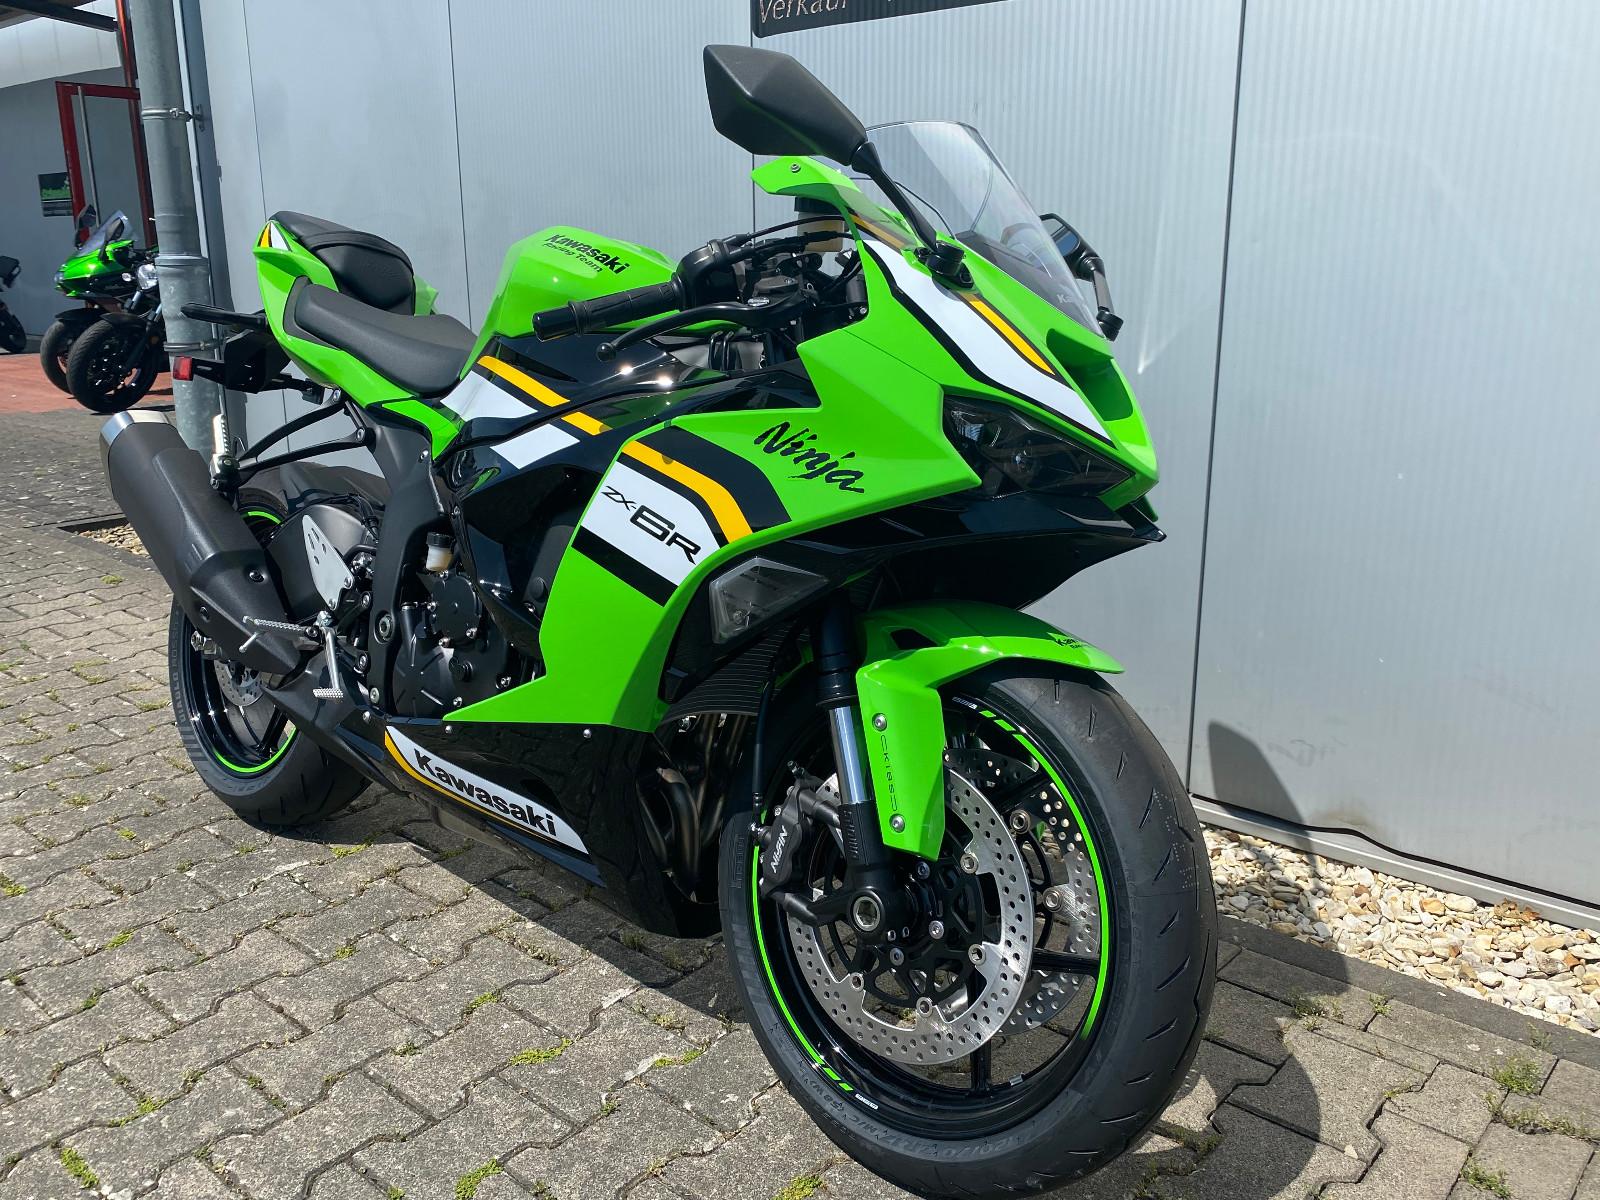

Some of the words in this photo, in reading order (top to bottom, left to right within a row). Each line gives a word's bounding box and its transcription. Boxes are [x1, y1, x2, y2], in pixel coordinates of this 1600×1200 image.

[542, 242, 575, 256] Racing
[575, 253, 603, 273] Team
[544, 234, 630, 274] Kawasaki
[753, 421, 865, 494] Ninja
[413, 748, 557, 837] Kawasaki
